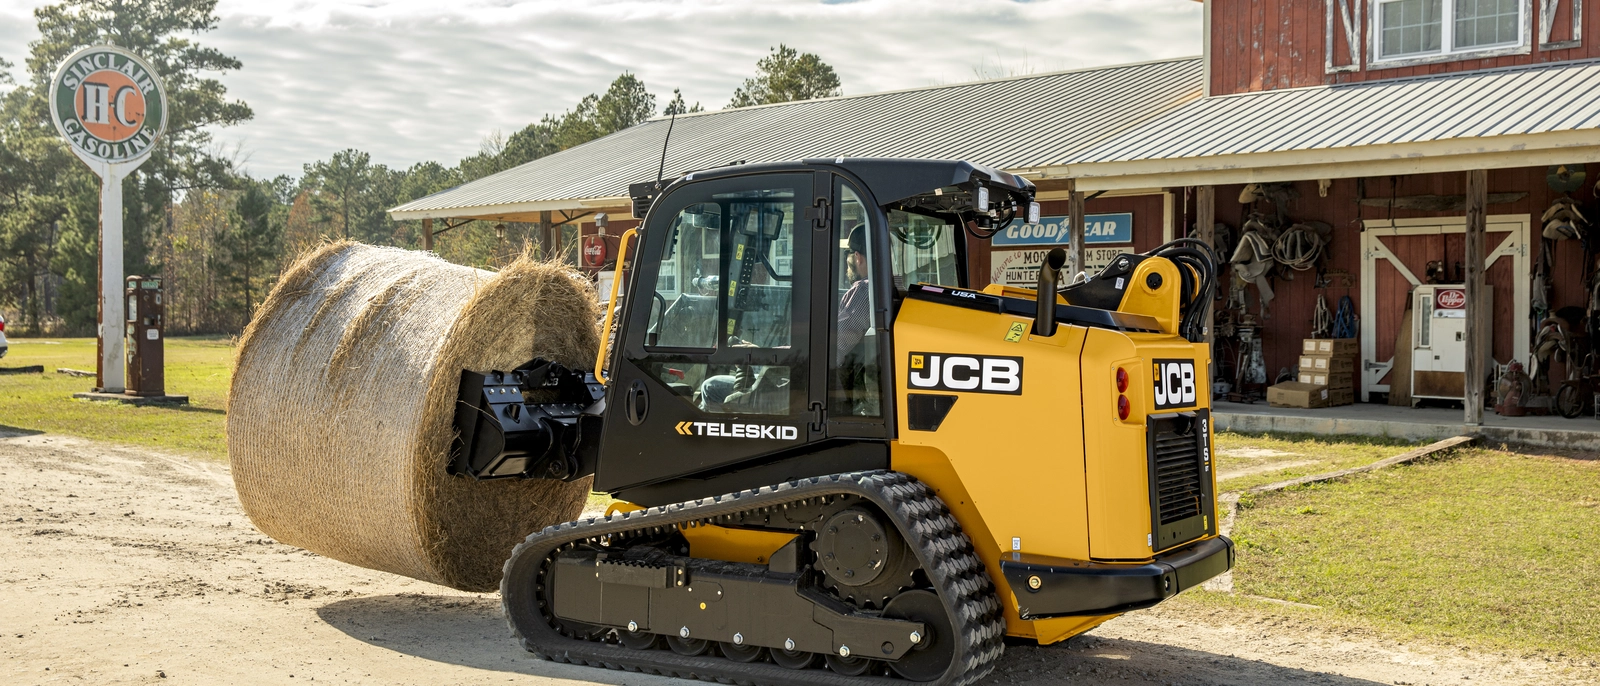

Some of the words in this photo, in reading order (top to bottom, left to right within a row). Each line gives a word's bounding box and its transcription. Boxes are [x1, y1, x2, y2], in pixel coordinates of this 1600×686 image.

[63, 53, 155, 95] SINCLAIR
[63, 118, 157, 158] GASOLINE
[1006, 221, 1117, 239] GOODEAR
[991, 256, 1013, 284] Welcome
[1014, 251, 1022, 260] to
[951, 289, 976, 299] USA
[910, 355, 1020, 392] JCB
[1154, 362, 1196, 406] JCB
[693, 421, 798, 440] TELESKID
